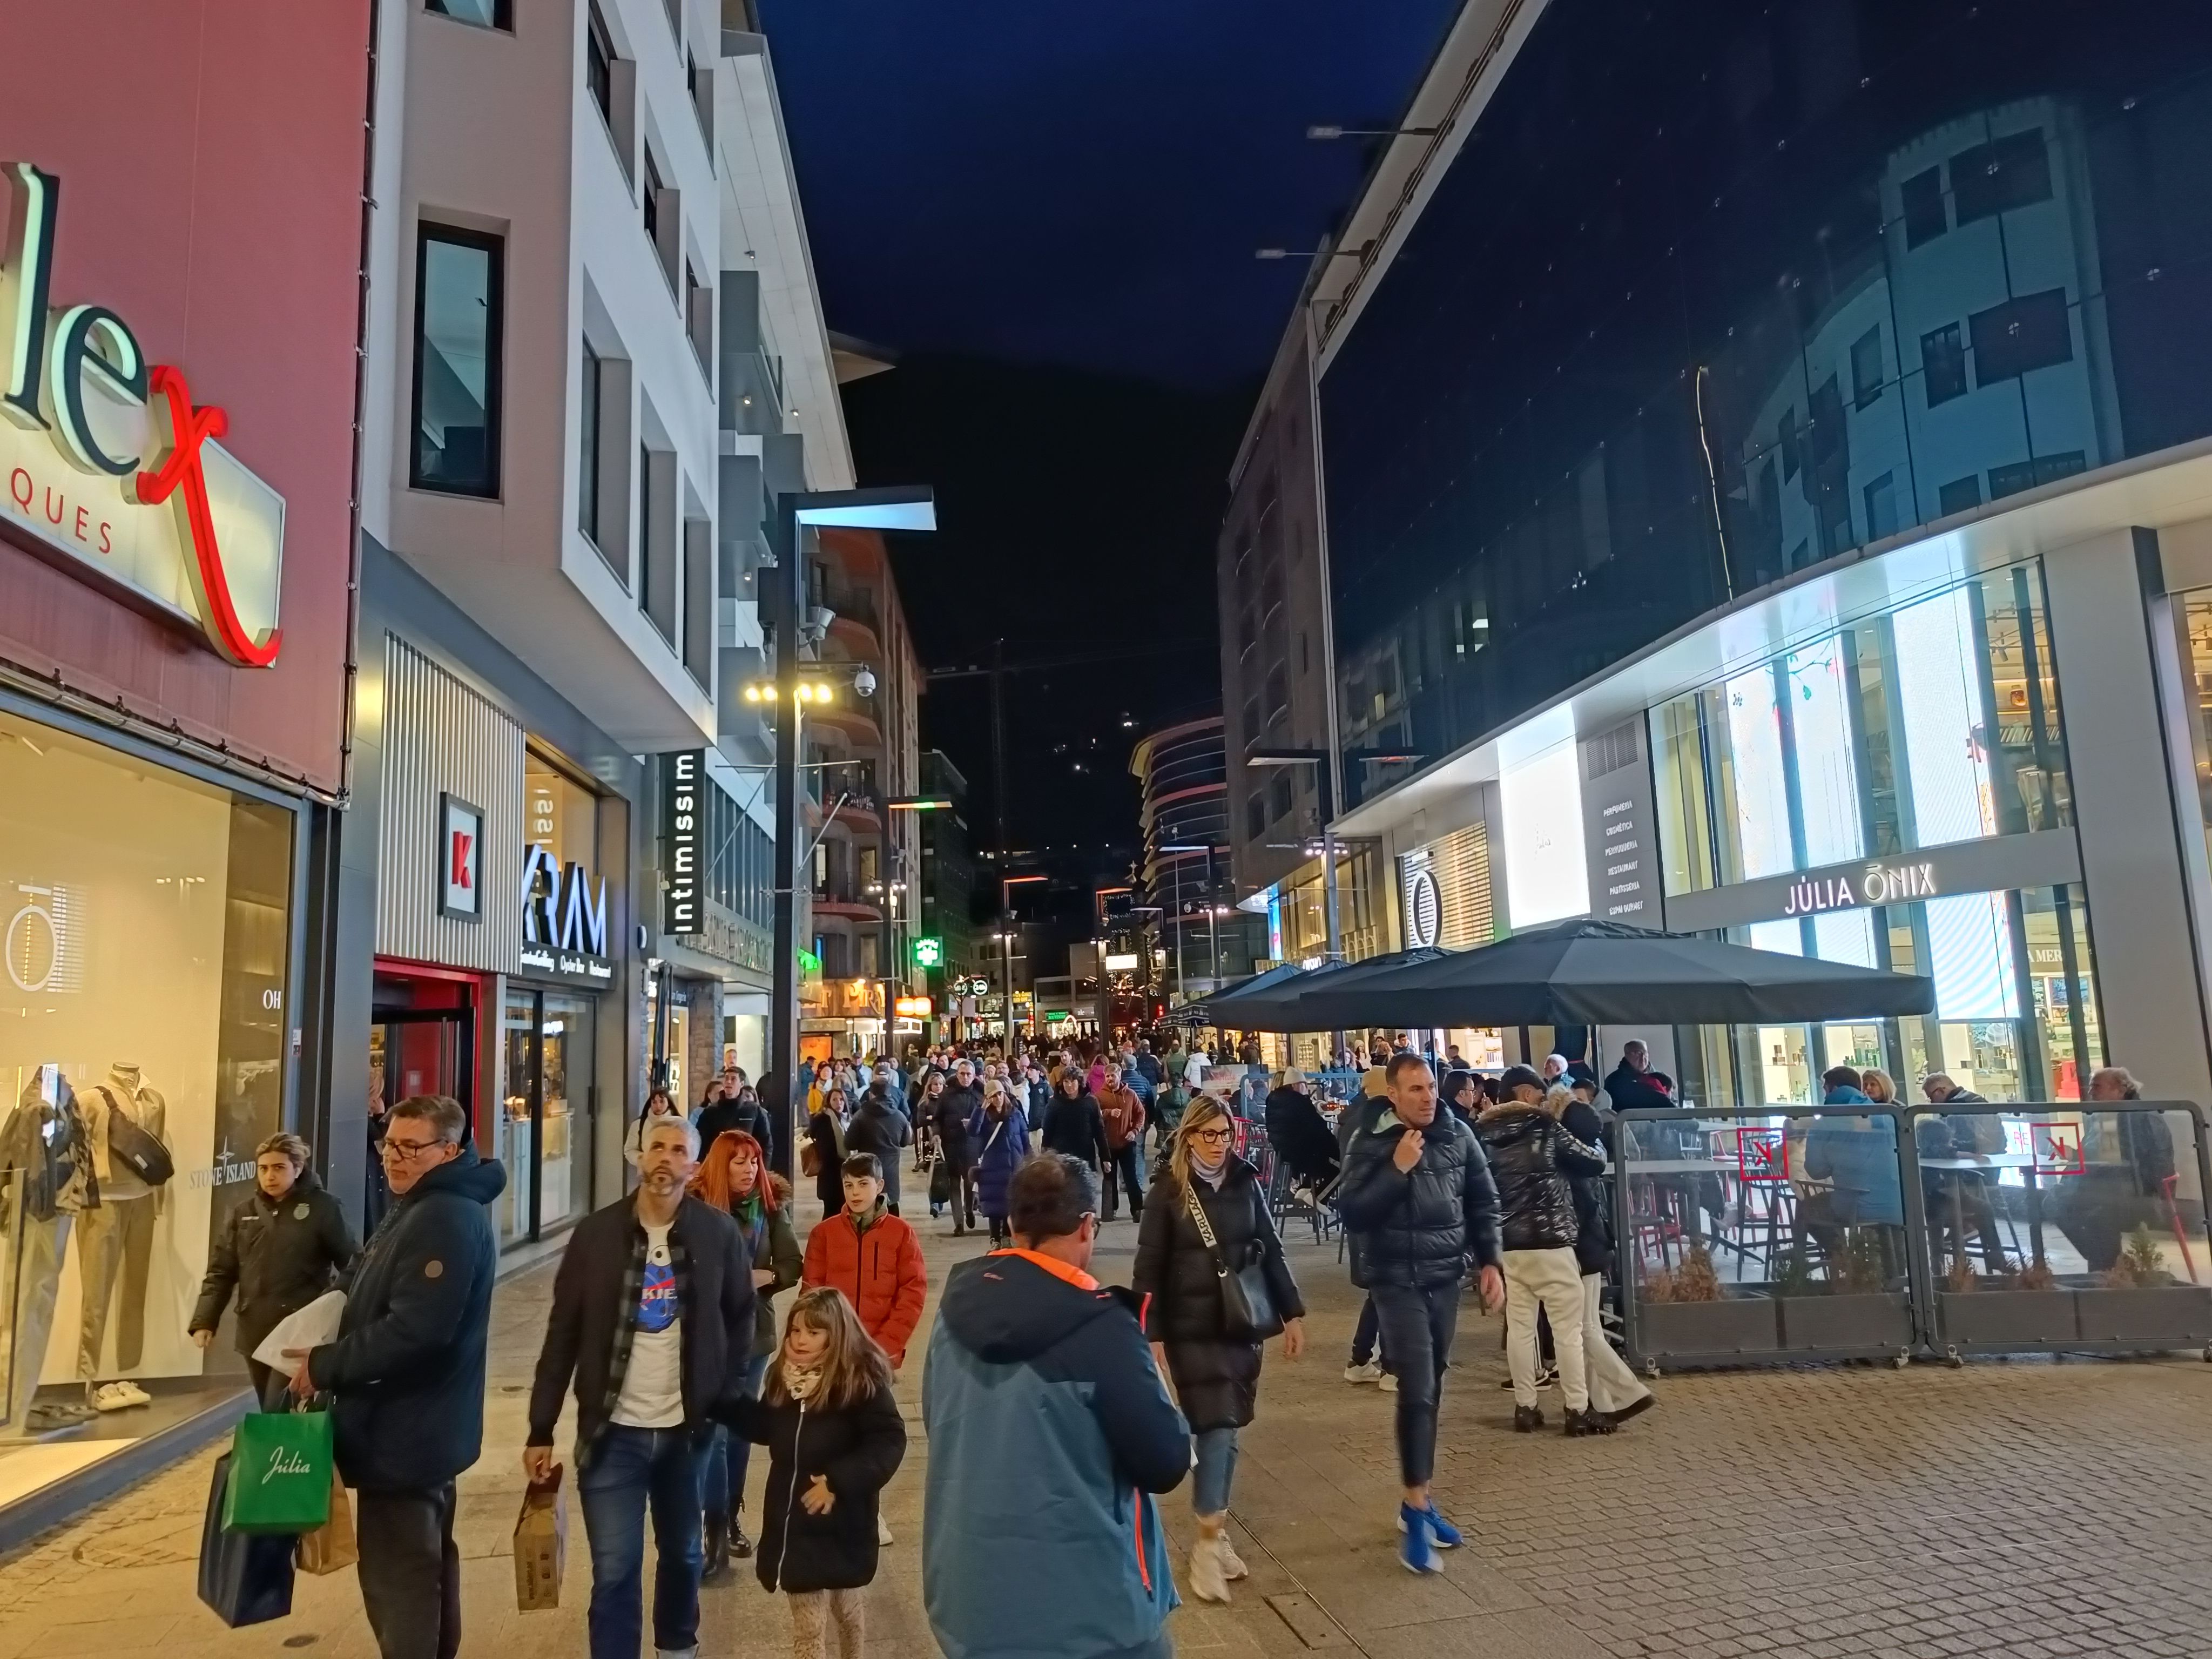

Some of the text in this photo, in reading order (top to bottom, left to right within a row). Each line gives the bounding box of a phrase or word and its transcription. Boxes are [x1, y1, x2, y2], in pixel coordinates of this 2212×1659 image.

[11, 468, 111, 554] QUES
[453, 831, 473, 888] K
[1608, 860, 1638, 875] RESTAURANT
[1609, 881, 1640, 895] PASTISSERIA
[1609, 905, 1623, 915] ESPAI
[2035, 949, 2062, 962] MER
[190, 1161, 257, 1189] STONE ISLAND
[261, 1446, 311, 1485] Júlia
